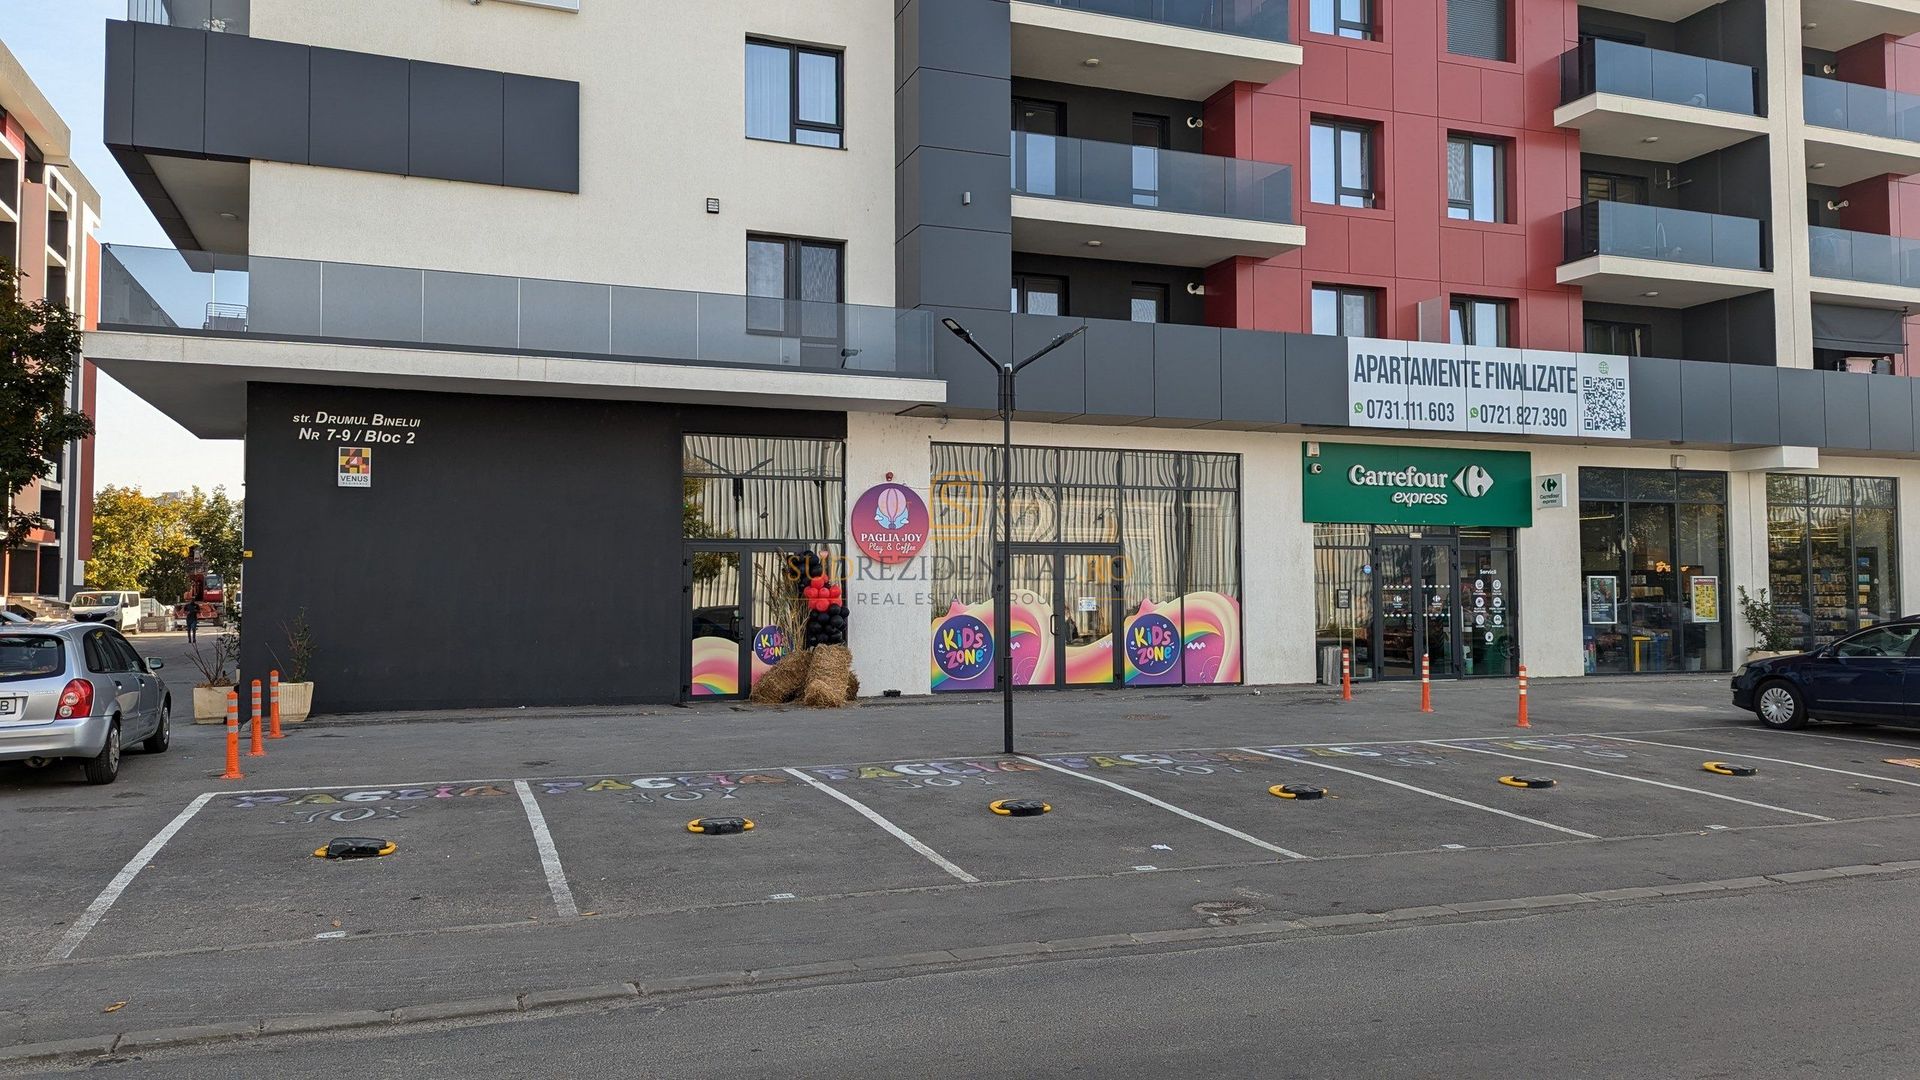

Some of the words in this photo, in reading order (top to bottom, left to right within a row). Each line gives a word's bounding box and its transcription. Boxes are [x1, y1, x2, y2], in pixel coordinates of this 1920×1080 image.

[1354, 354, 1481, 389] APARTAMENTE
[1485, 361, 1577, 393] FINALIZATE
[293, 413, 311, 423] str.
[1366, 399, 1455, 422] 0731.111.603
[1480, 404, 1568, 427] 0721.827.390
[327, 429, 351, 441] 7-9
[354, 430, 361, 441] /
[365, 430, 401, 443] Bloc
[406, 432, 415, 444] 2
[340, 475, 369, 483] VENUS
[1348, 464, 1448, 488] Carrefour
[1391, 491, 1448, 507] express
[861, 533, 900, 542] PAGLIA
[902, 533, 922, 543] JOY
[868, 543, 883, 554] Play
[887, 542, 892, 551] &
